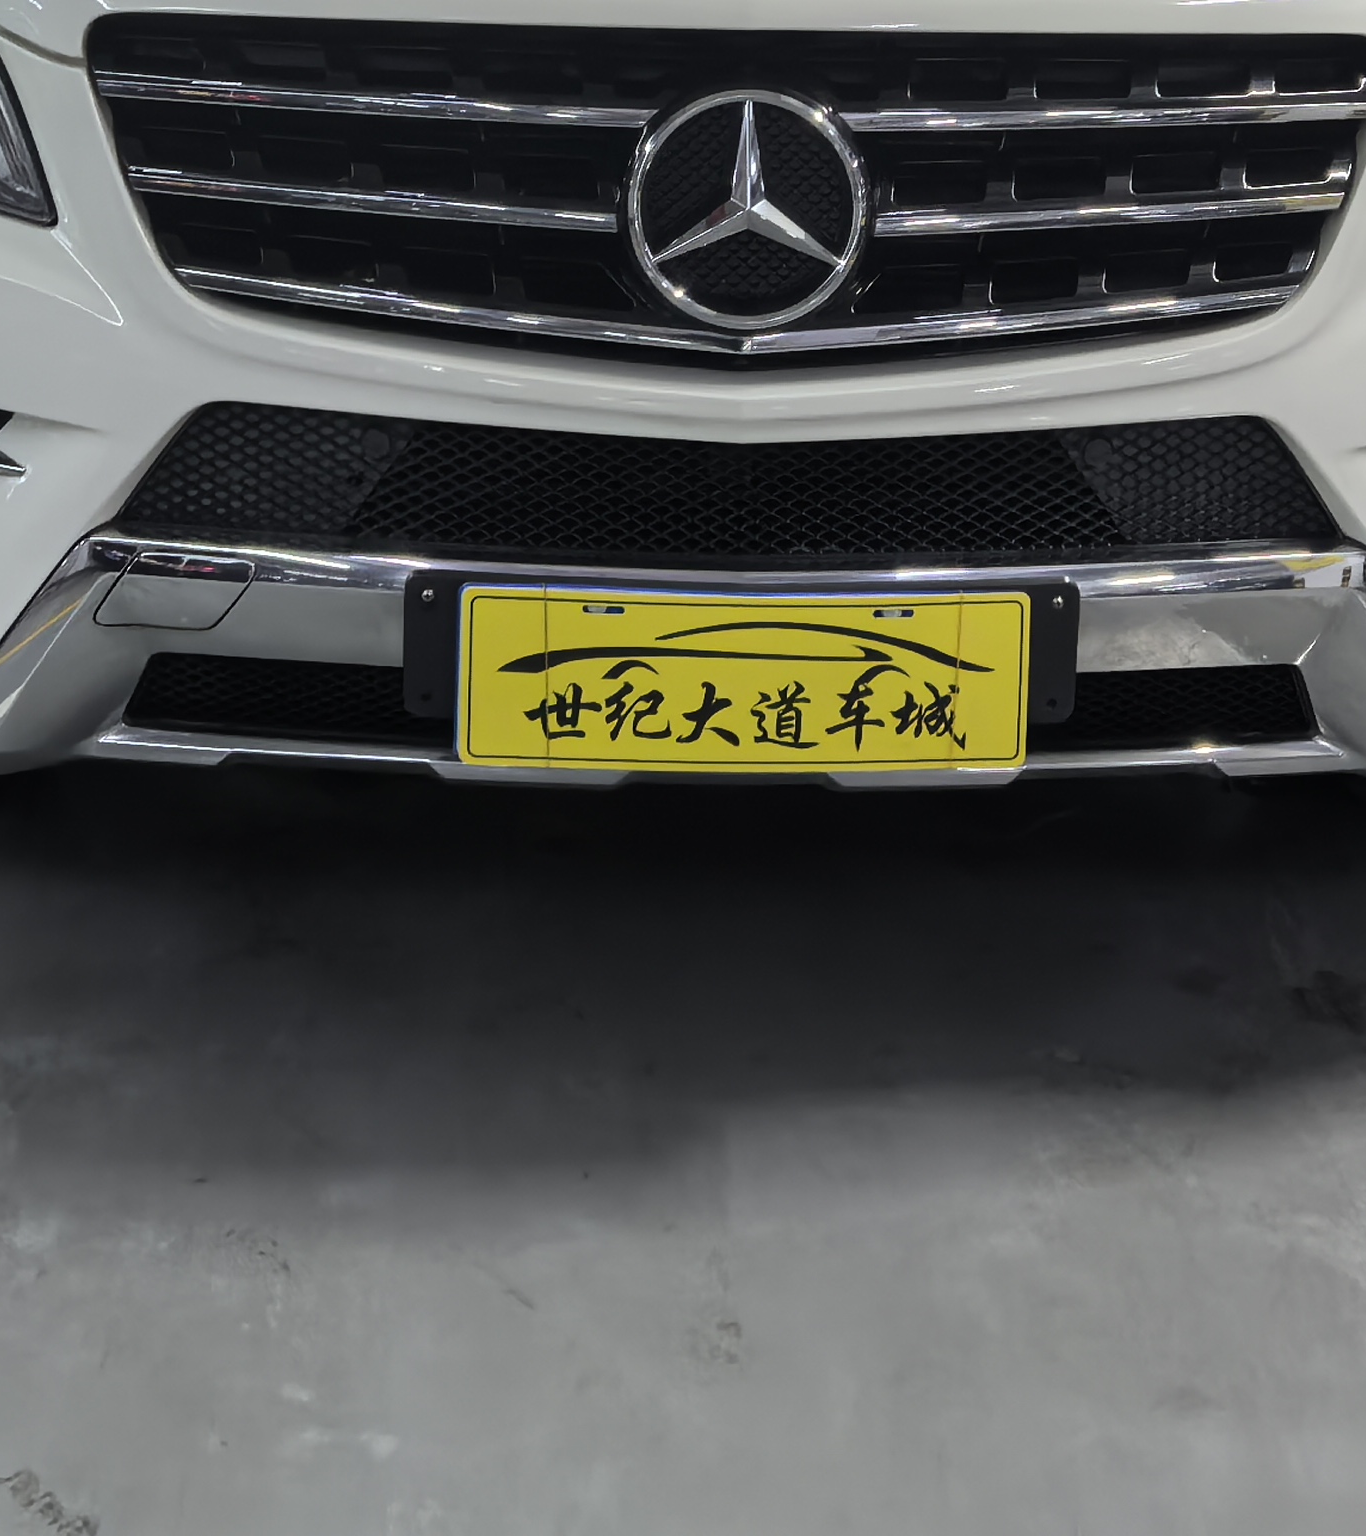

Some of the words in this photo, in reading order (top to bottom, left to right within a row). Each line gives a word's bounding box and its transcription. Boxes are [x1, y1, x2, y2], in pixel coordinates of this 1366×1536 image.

[523, 680, 968, 752] 世纪大道车城
